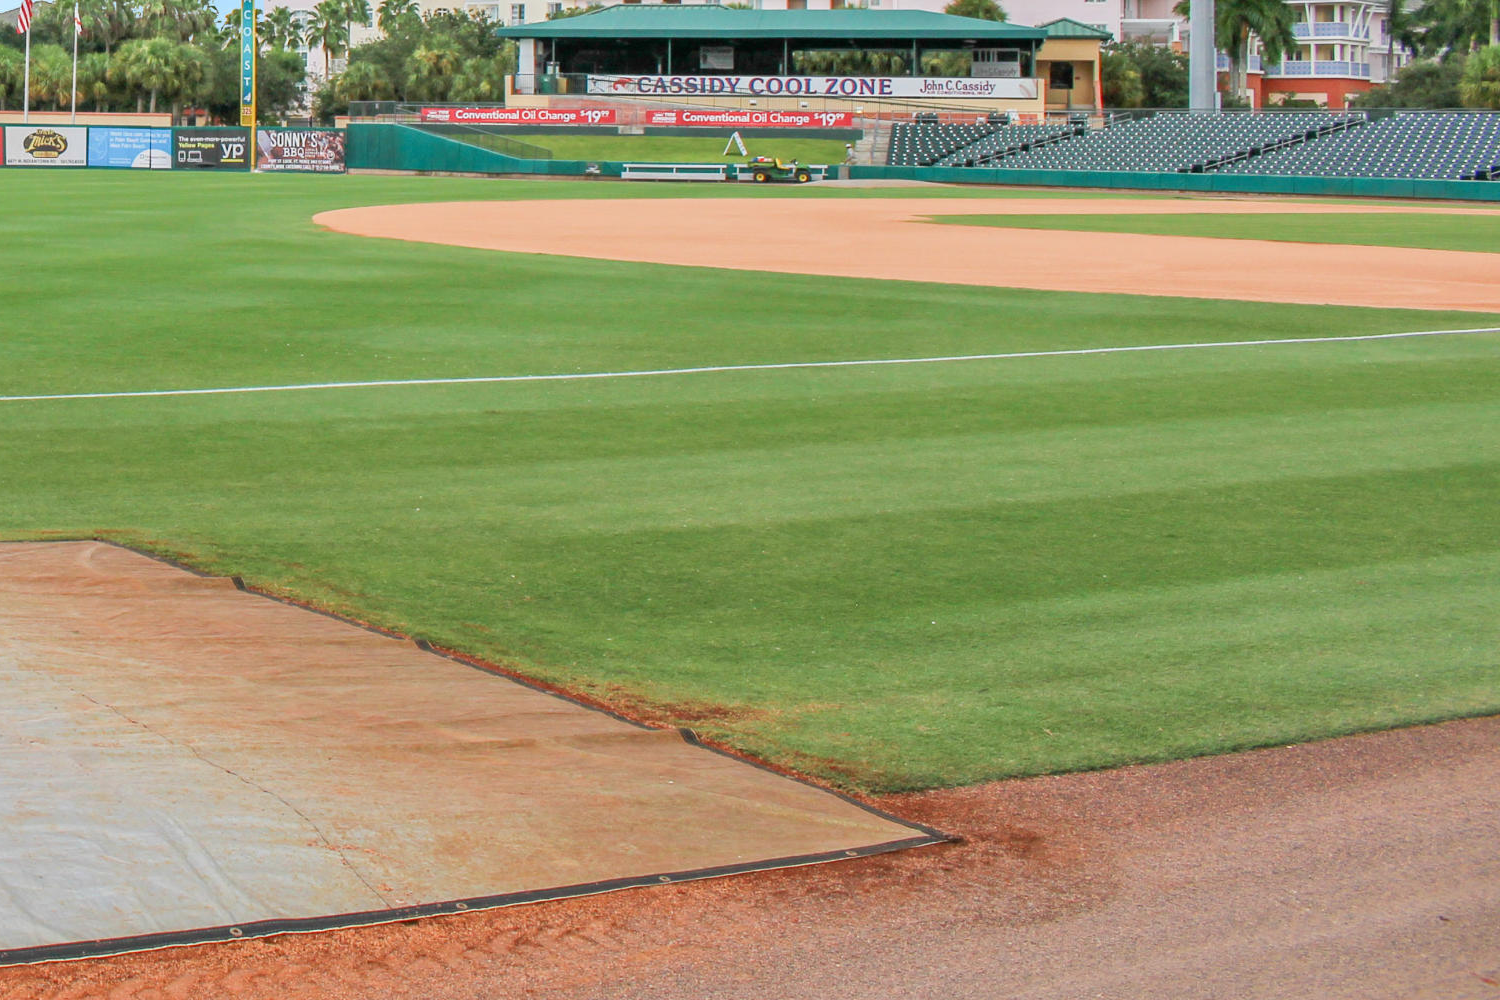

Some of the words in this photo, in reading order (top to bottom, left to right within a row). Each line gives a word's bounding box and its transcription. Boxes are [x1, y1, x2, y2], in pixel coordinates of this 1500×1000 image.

[637, 77, 740, 94] CASSIDY
[749, 78, 817, 94] COOL
[825, 78, 893, 95] ZONE
[920, 79, 944, 93] John
[946, 80, 955, 91] C.
[955, 80, 996, 94] Cassidy
[455, 110, 519, 120] Conventional
[522, 110, 536, 120] Oil
[538, 110, 576, 122] Change
[682, 112, 749, 123] Conventional
[752, 112, 767, 123] Oil
[769, 113, 810, 125] Change
[270, 132, 318, 147] SONNY'S
[221, 143, 244, 158] yp
[283, 148, 305, 158] BBQ
